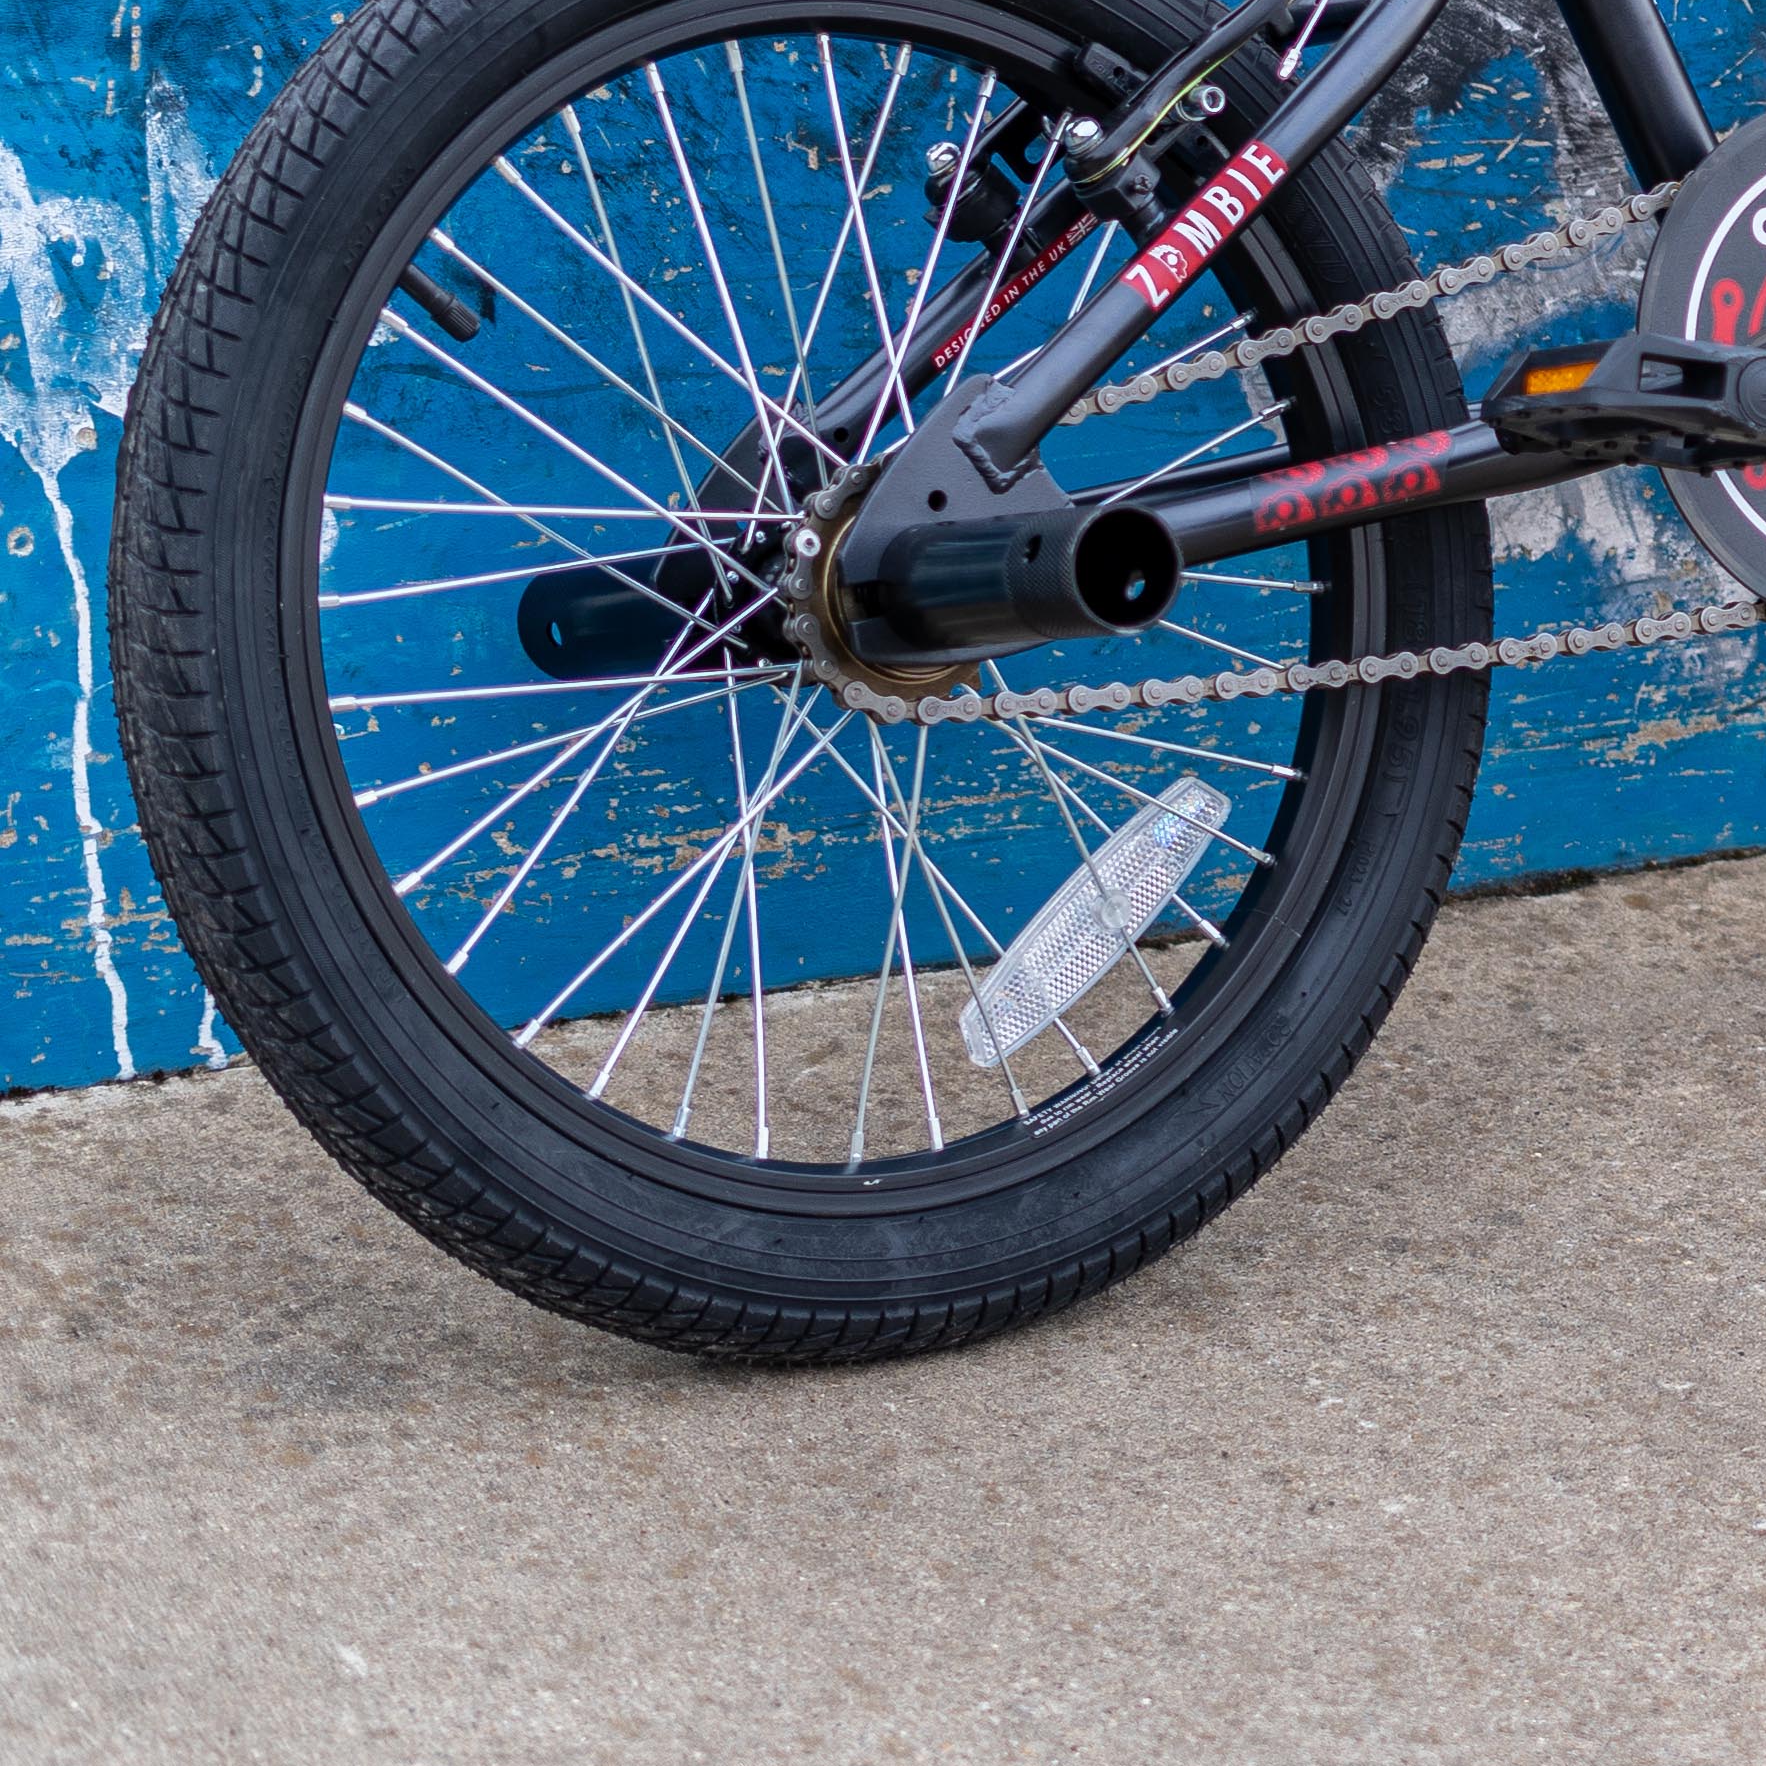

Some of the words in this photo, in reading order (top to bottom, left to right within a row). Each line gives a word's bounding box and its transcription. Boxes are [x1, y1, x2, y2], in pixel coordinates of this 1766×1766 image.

[1003, 285, 1020, 304] IN
[1022, 260, 1047, 287] THE
[1049, 241, 1067, 262] UK
[1095, 1067, 1124, 1088] Replace
[1096, 1082, 1116, 1096] Wear
[1115, 1063, 1141, 1083] Groove
